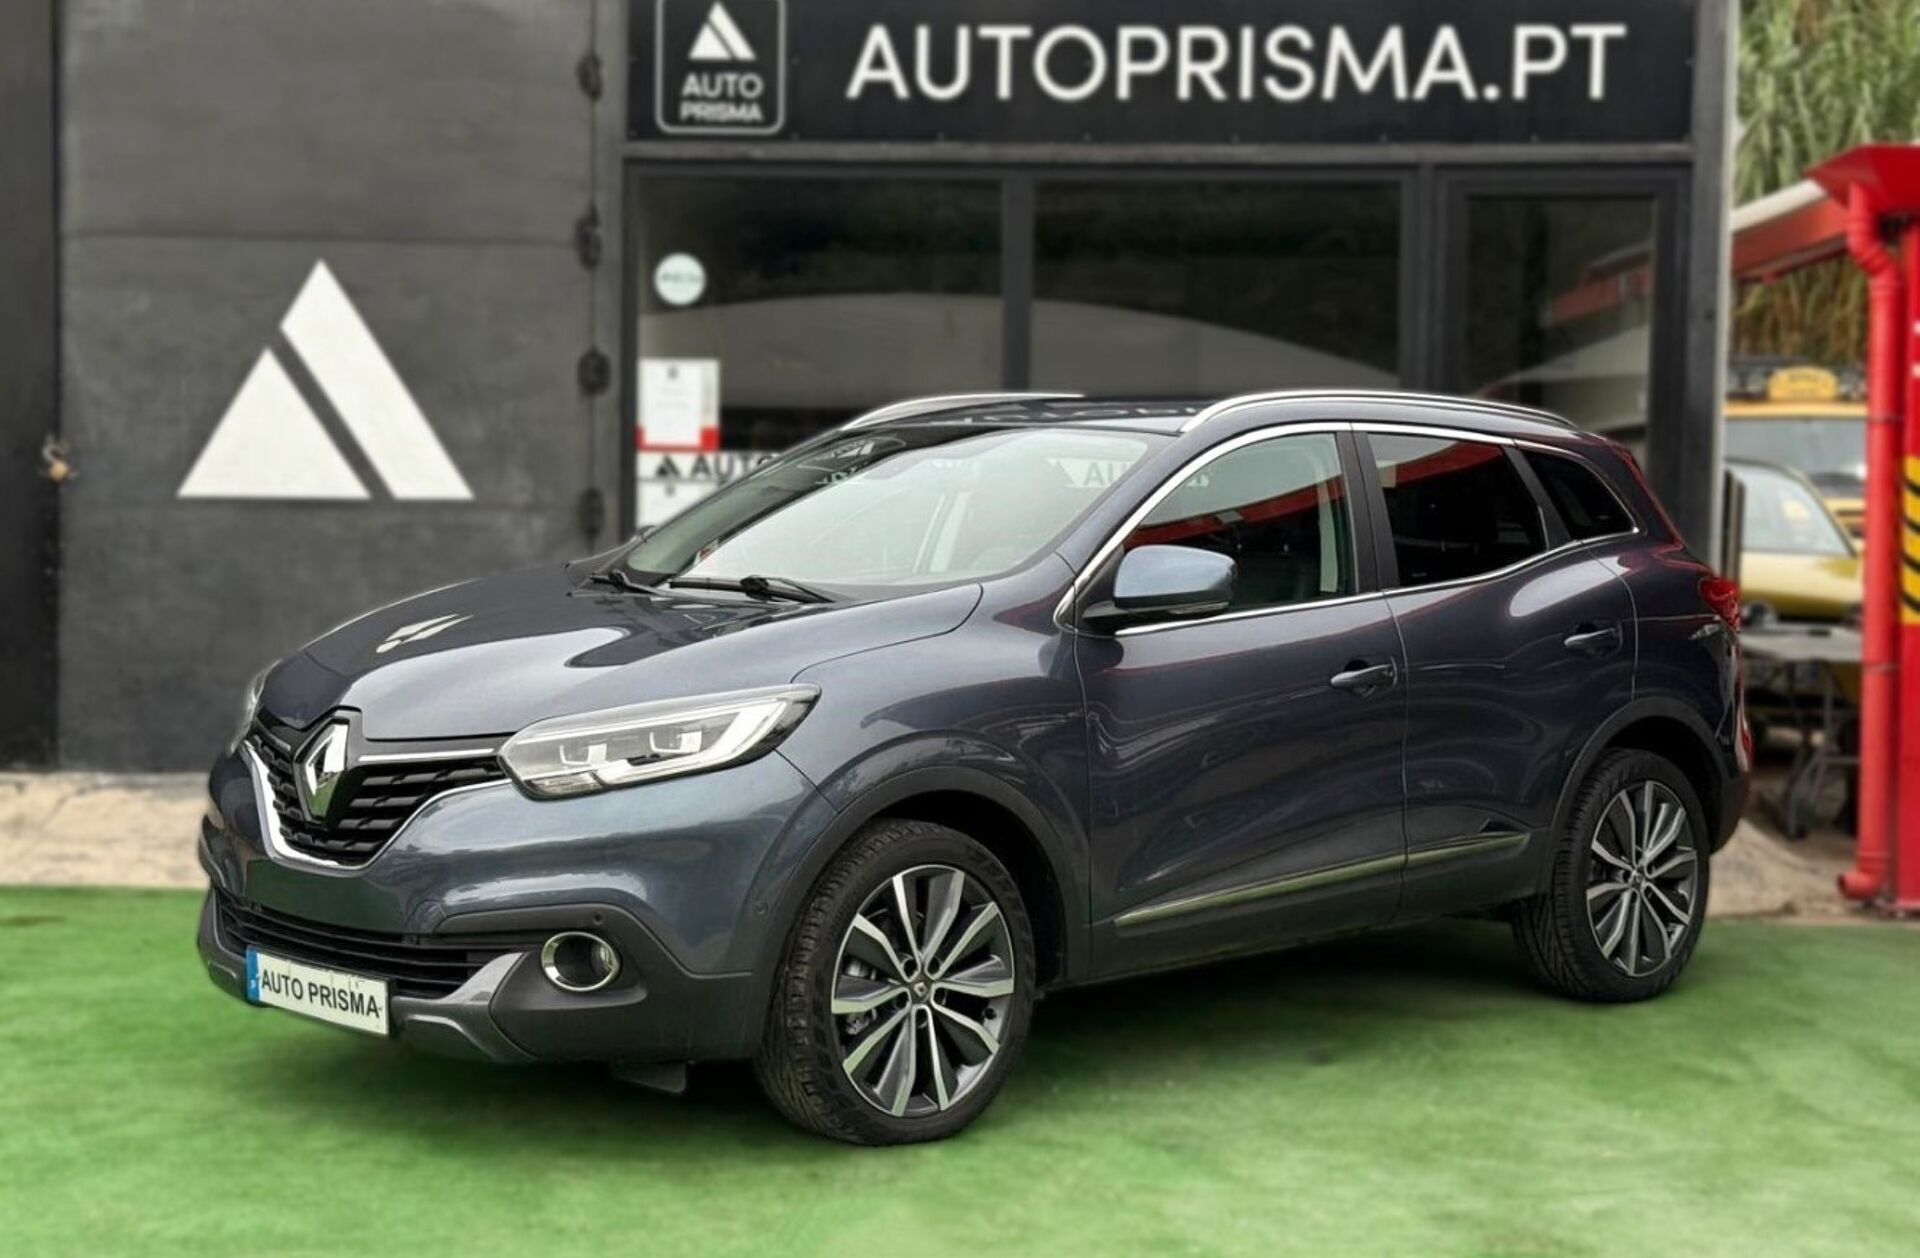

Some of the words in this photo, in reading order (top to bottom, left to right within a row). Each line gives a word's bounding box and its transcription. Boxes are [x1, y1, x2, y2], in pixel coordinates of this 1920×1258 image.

[846, 24, 1627, 102] AUTOPRISMA.PT
[681, 72, 764, 99] AUTO
[680, 101, 763, 121] PRISMA
[261, 969, 304, 1000] AUTO
[308, 981, 380, 1018] PRISMA
